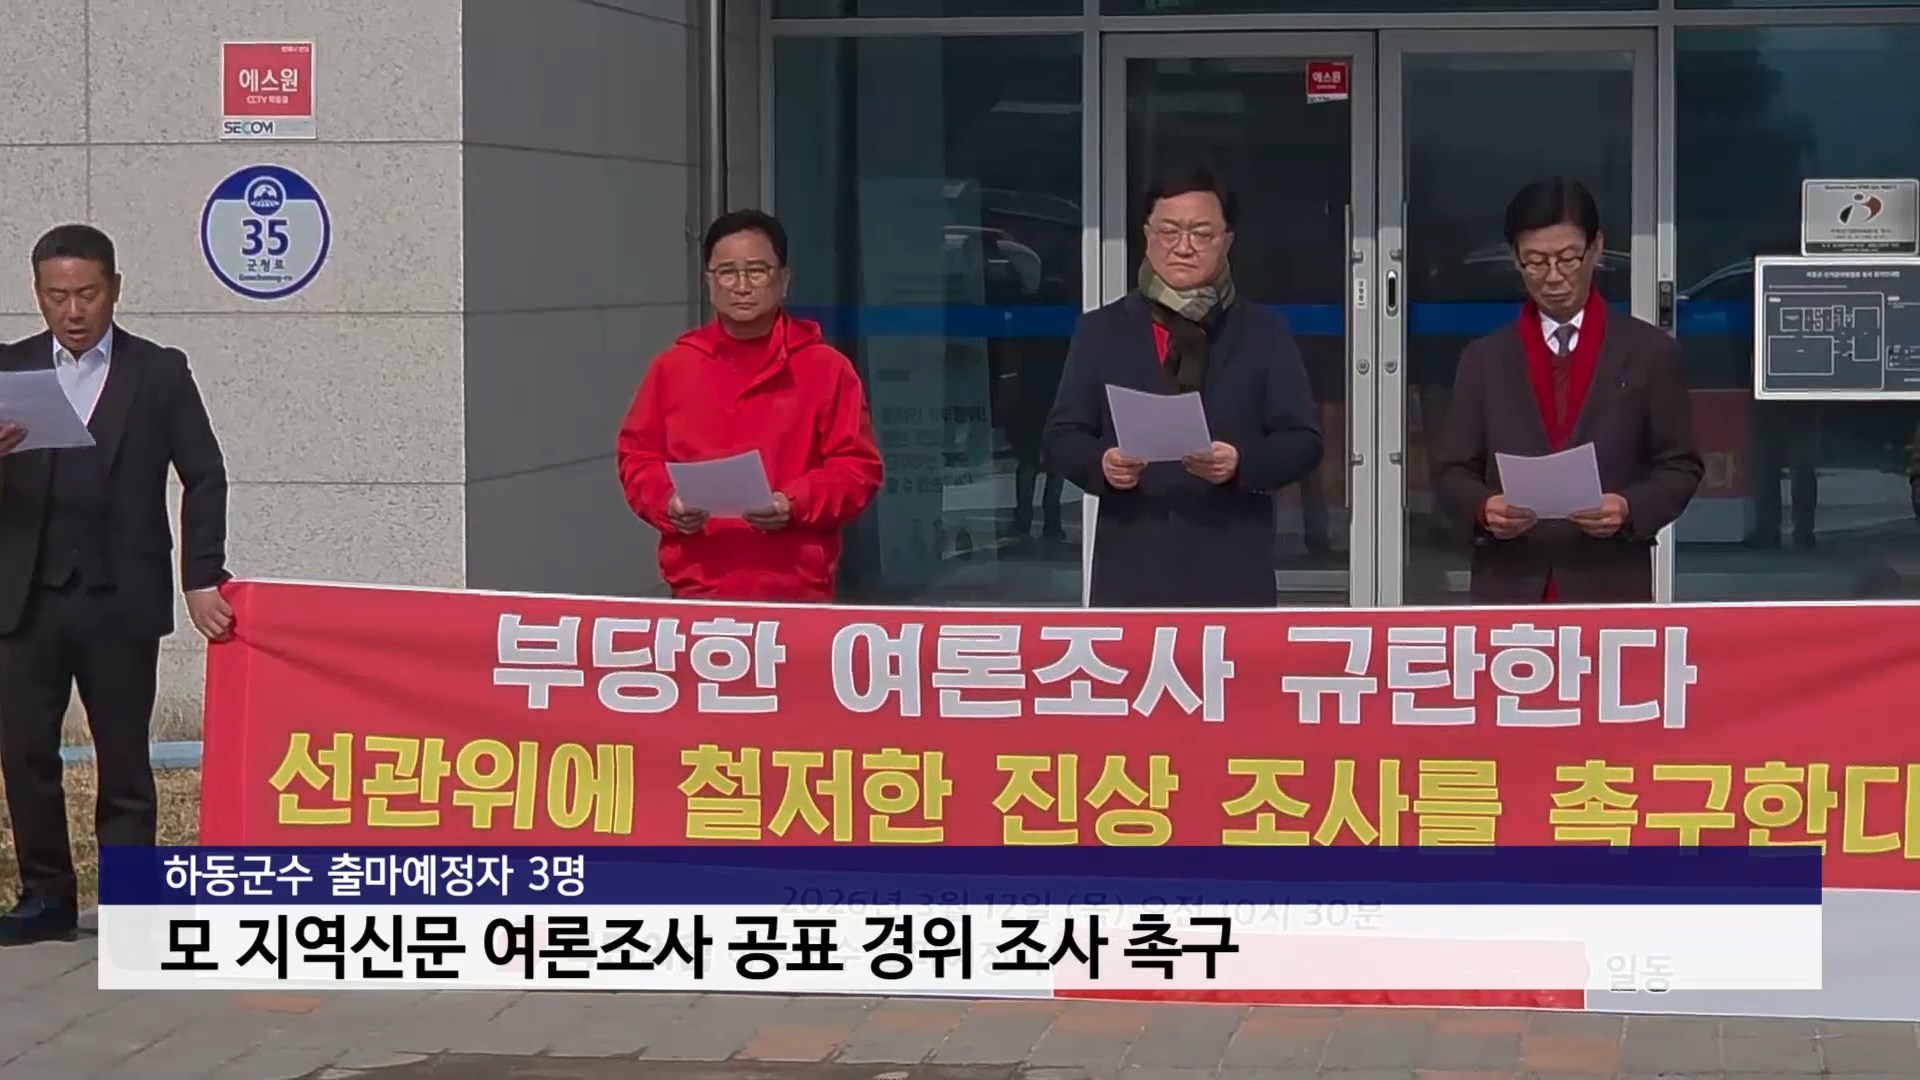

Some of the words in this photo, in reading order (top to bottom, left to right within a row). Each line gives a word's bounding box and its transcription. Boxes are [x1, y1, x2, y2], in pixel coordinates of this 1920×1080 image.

[239, 68, 298, 92] 에스원
[224, 121, 274, 135] SECOM
[241, 218, 289, 256] 35
[247, 258, 285, 273] 군청로
[493, 614, 786, 713] 부당한
[831, 622, 1235, 723] 여론조사
[1281, 623, 1698, 728] 규탄한다
[269, 732, 634, 834] 선관위에
[679, 745, 952, 843] 철저한
[992, 753, 1179, 847] 진상
[1222, 758, 1502, 848] 조사를
[1549, 759, 1920, 859] 촉구한다
[1606, 953, 1675, 993] 일동
